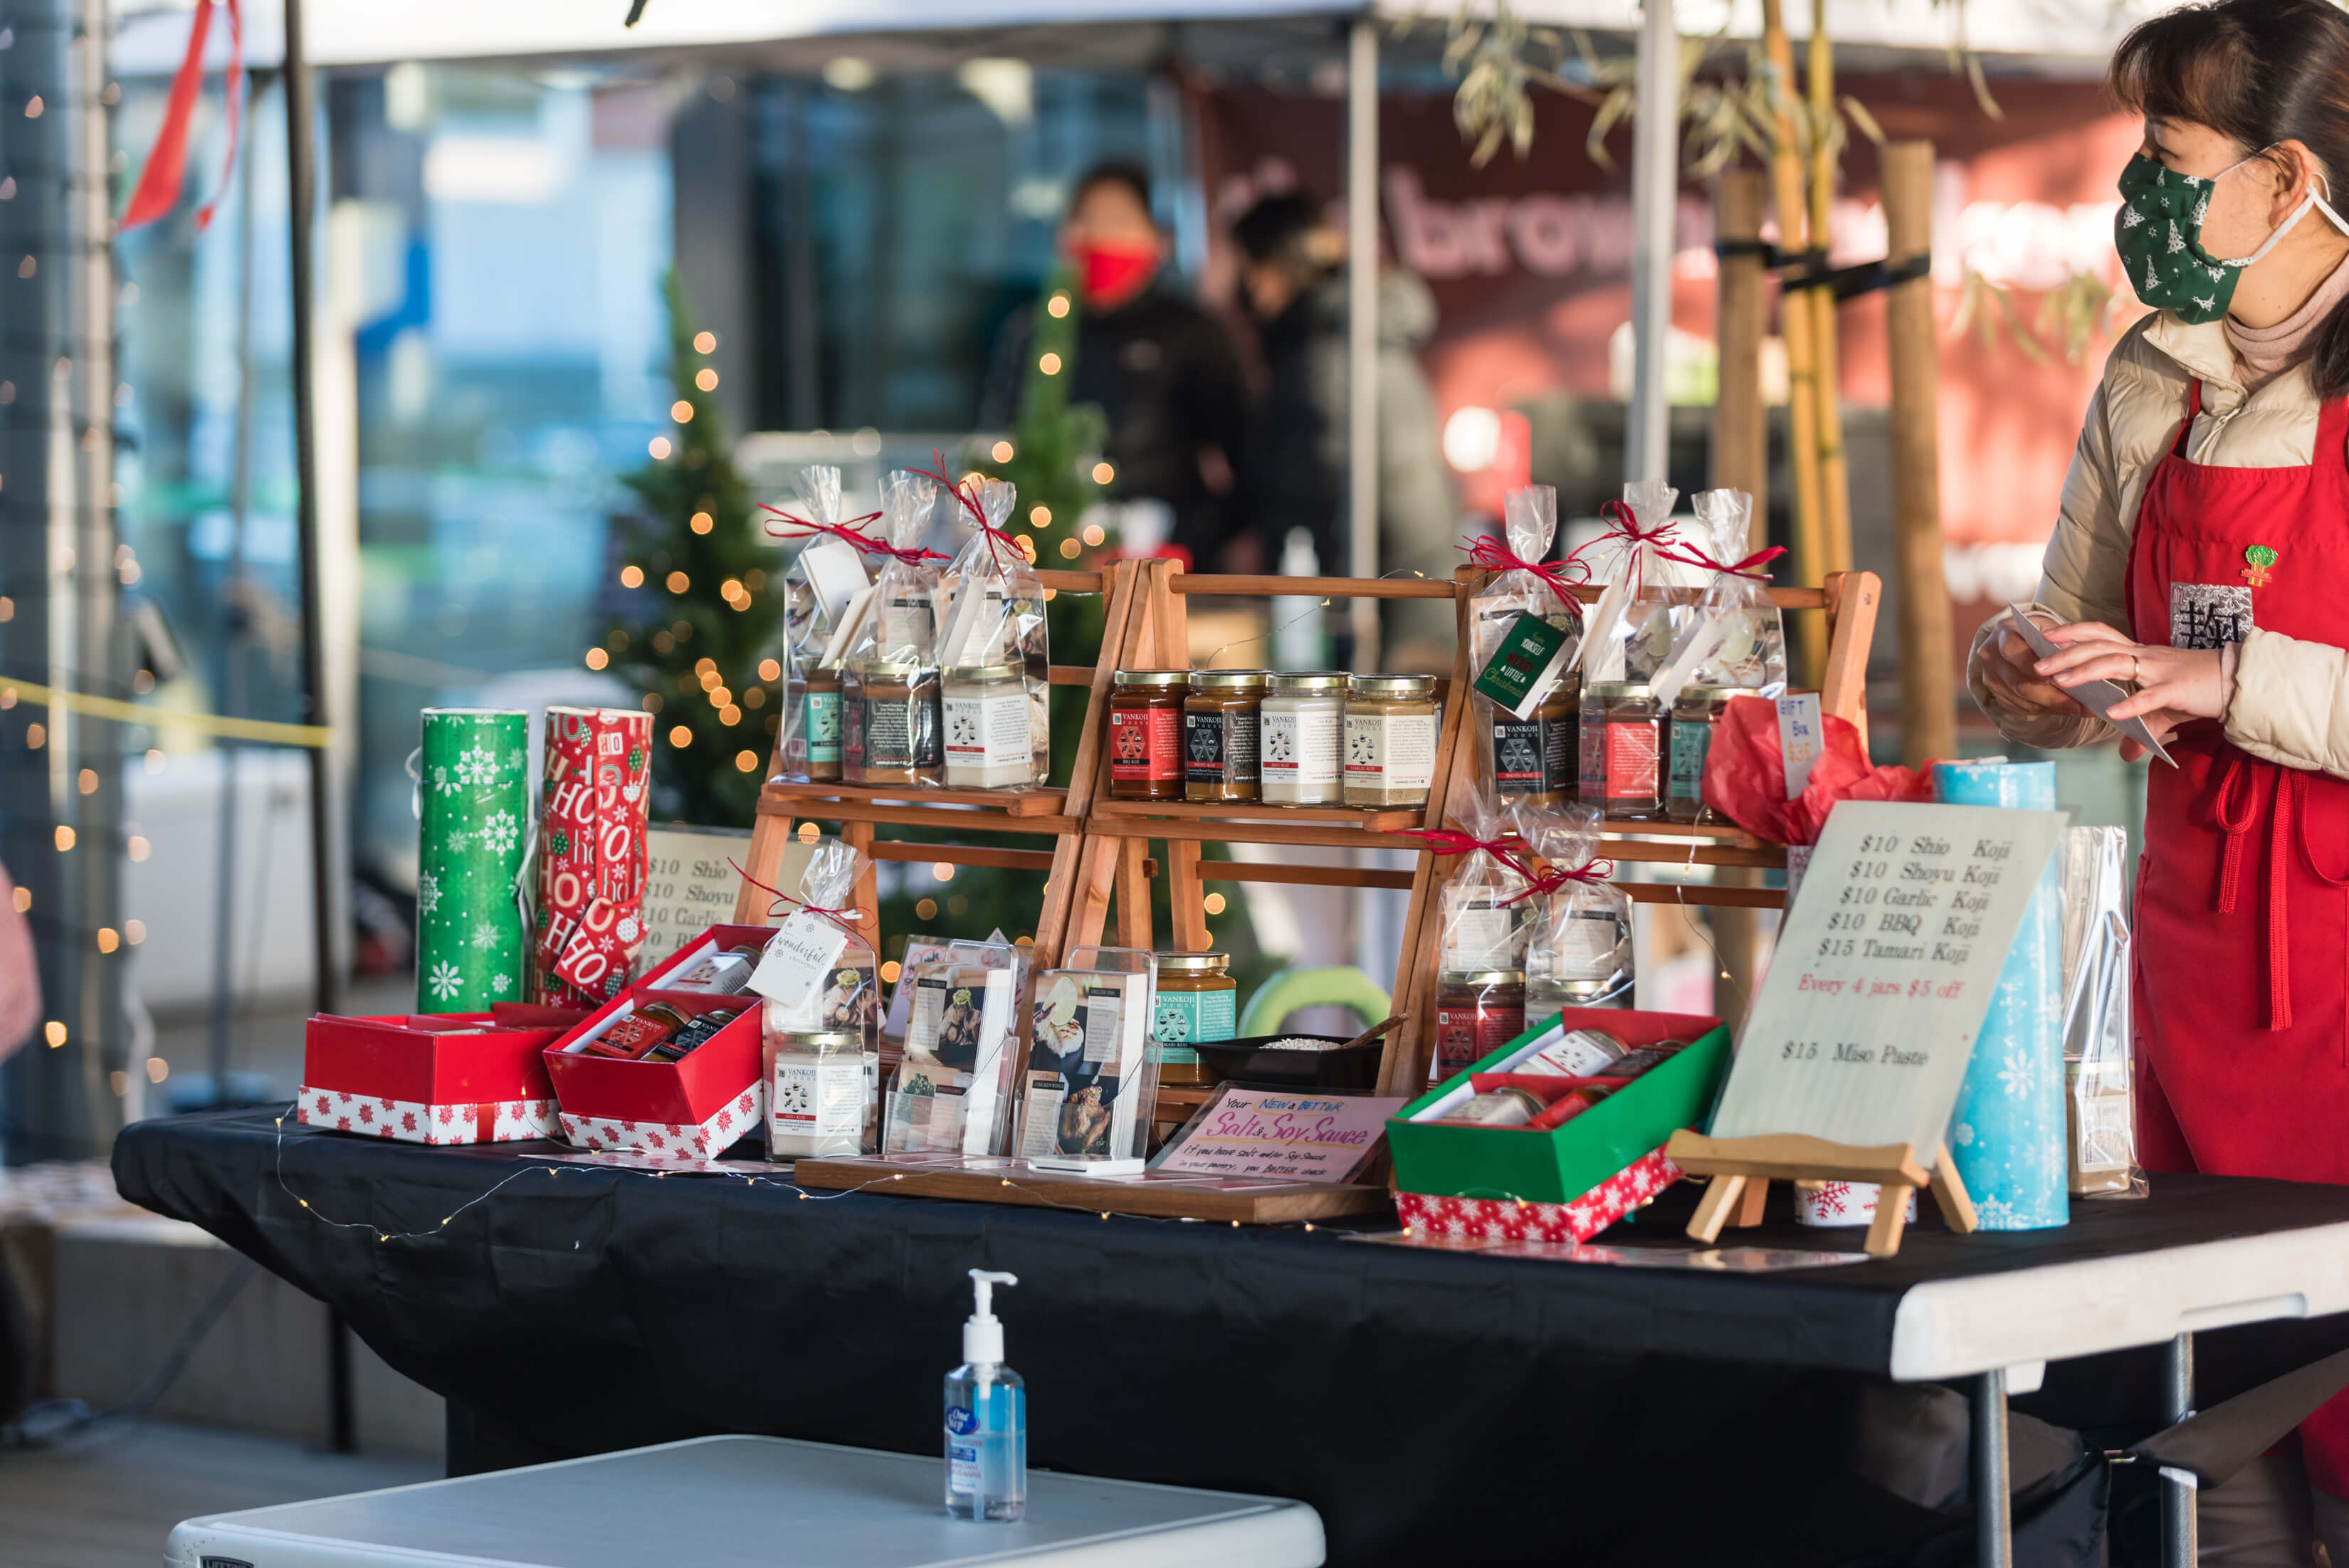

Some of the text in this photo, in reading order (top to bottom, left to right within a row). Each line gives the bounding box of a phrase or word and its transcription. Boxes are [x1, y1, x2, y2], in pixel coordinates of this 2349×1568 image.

[1520, 638, 1545, 656] YOURSELF
[1484, 668, 1524, 698] Christmas
[1504, 666, 1523, 683] LITTLE
[1780, 700, 1804, 716] GIFT
[1788, 742, 1812, 762] $35
[1860, 834, 2013, 861] $10 Shio Koji
[691, 860, 727, 878] Shio
[1849, 861, 2003, 888] $10 Shoyu Koji
[685, 883, 735, 905] Shoyu
[1840, 887, 1991, 913] $10 Garlic Koji
[643, 907, 669, 925] 10
[1828, 912, 1982, 940] $10 BBQ Koji
[560, 927, 607, 984] HO
[777, 937, 826, 963] wonderful
[1818, 937, 1972, 965] $15 Tamari Koji
[1798, 973, 1965, 999] Every 4 jars $5 off
[1782, 1040, 1930, 1067] $15 Miso Paste
[788, 1068, 816, 1077] VANKOJI
[1226, 1098, 1251, 1110] Your
[1258, 1098, 1286, 1110] NEW
[1296, 1100, 1344, 1111] BETTER
[1206, 1111, 1261, 1137] Salt
[1261, 1112, 1310, 1147] Soy
[1303, 1116, 1368, 1145] Sauce
[1184, 1145, 1200, 1154] If
[1196, 1147, 1212, 1157] you
[1214, 1146, 1236, 1157] have
[1236, 1147, 1258, 1158] salt
[1300, 1152, 1326, 1162] Sauce
[1242, 1165, 1260, 1174] you
[954, 1409, 969, 1421] One
